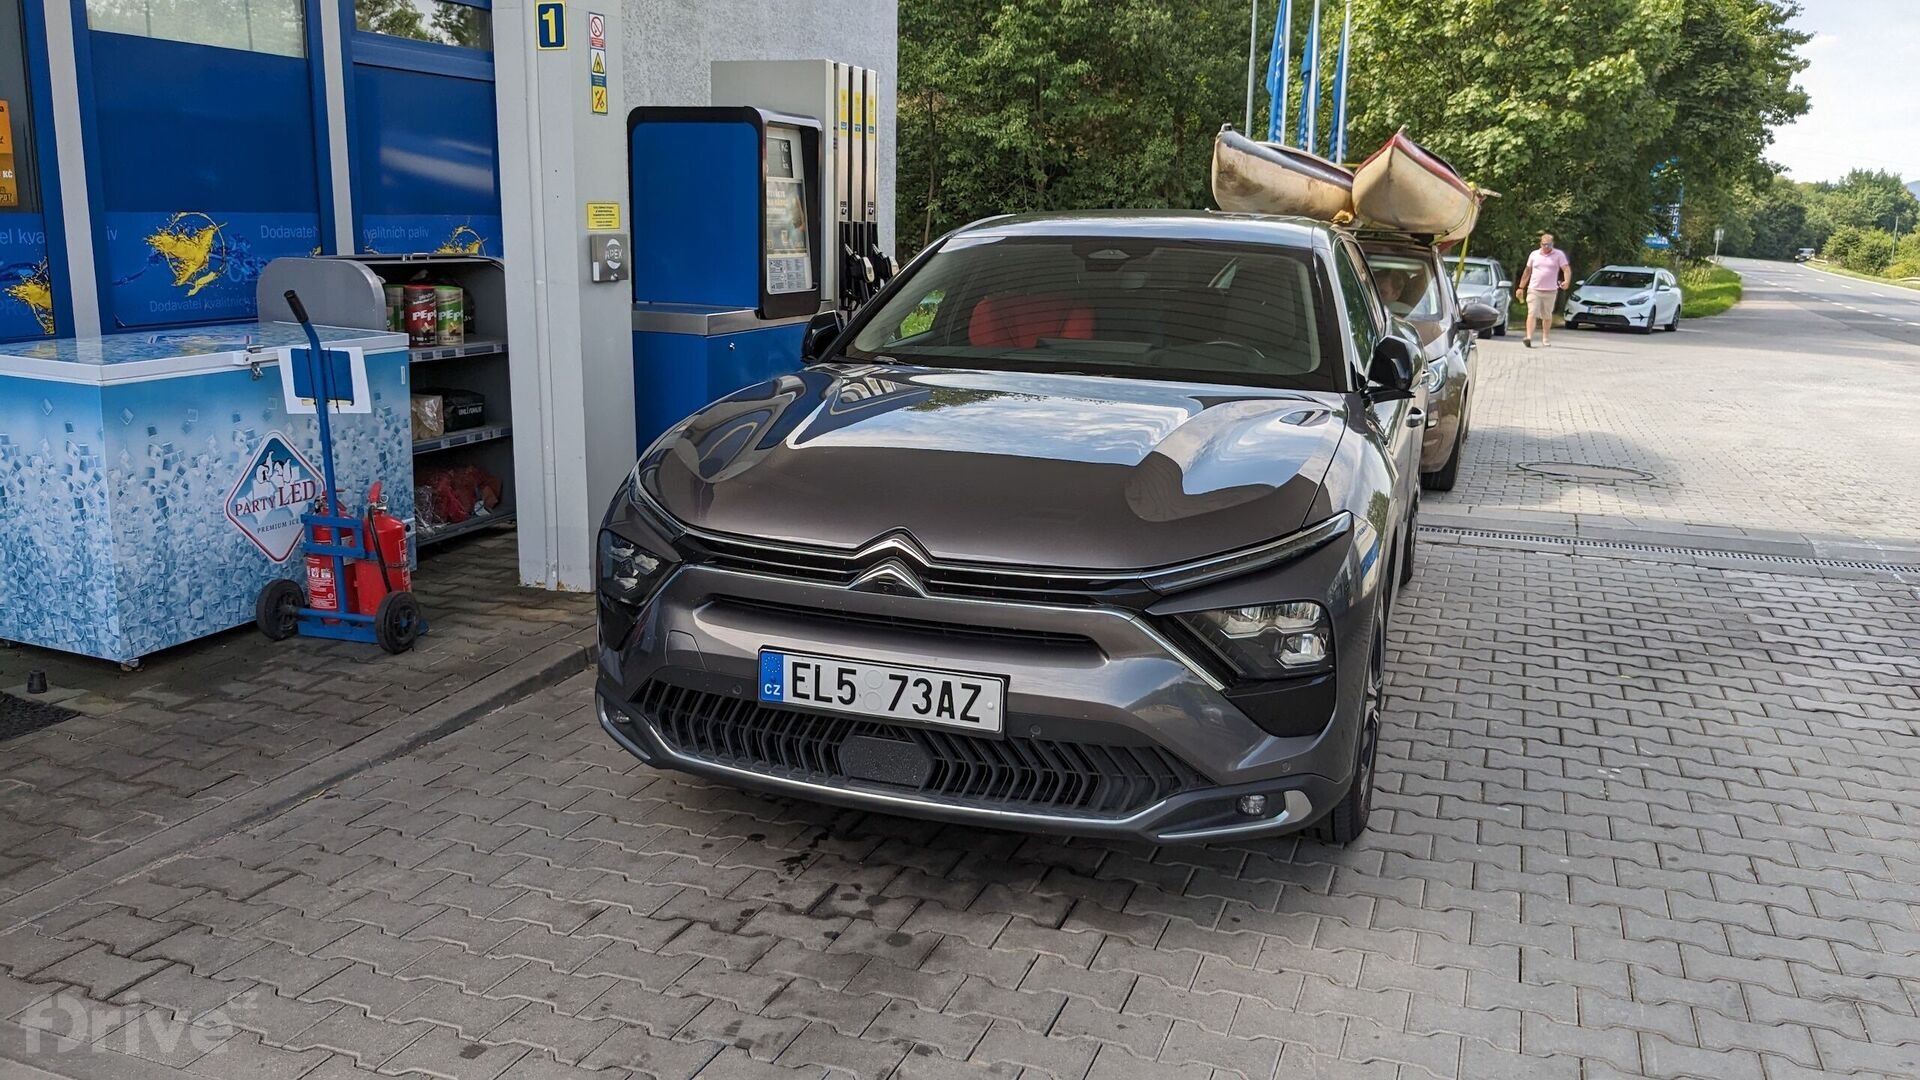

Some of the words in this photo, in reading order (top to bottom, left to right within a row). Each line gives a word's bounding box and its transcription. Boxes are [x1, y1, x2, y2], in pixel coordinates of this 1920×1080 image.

[542, 7, 557, 43] 1
[150, 298, 202, 313] Dodavatel
[235, 496, 275, 517] PARTY
[278, 480, 316, 506] LED
[257, 521, 287, 534] PREMIUM
[764, 683, 781, 696] CZ
[791, 661, 857, 705] EL5
[888, 674, 982, 723] 73AZ
